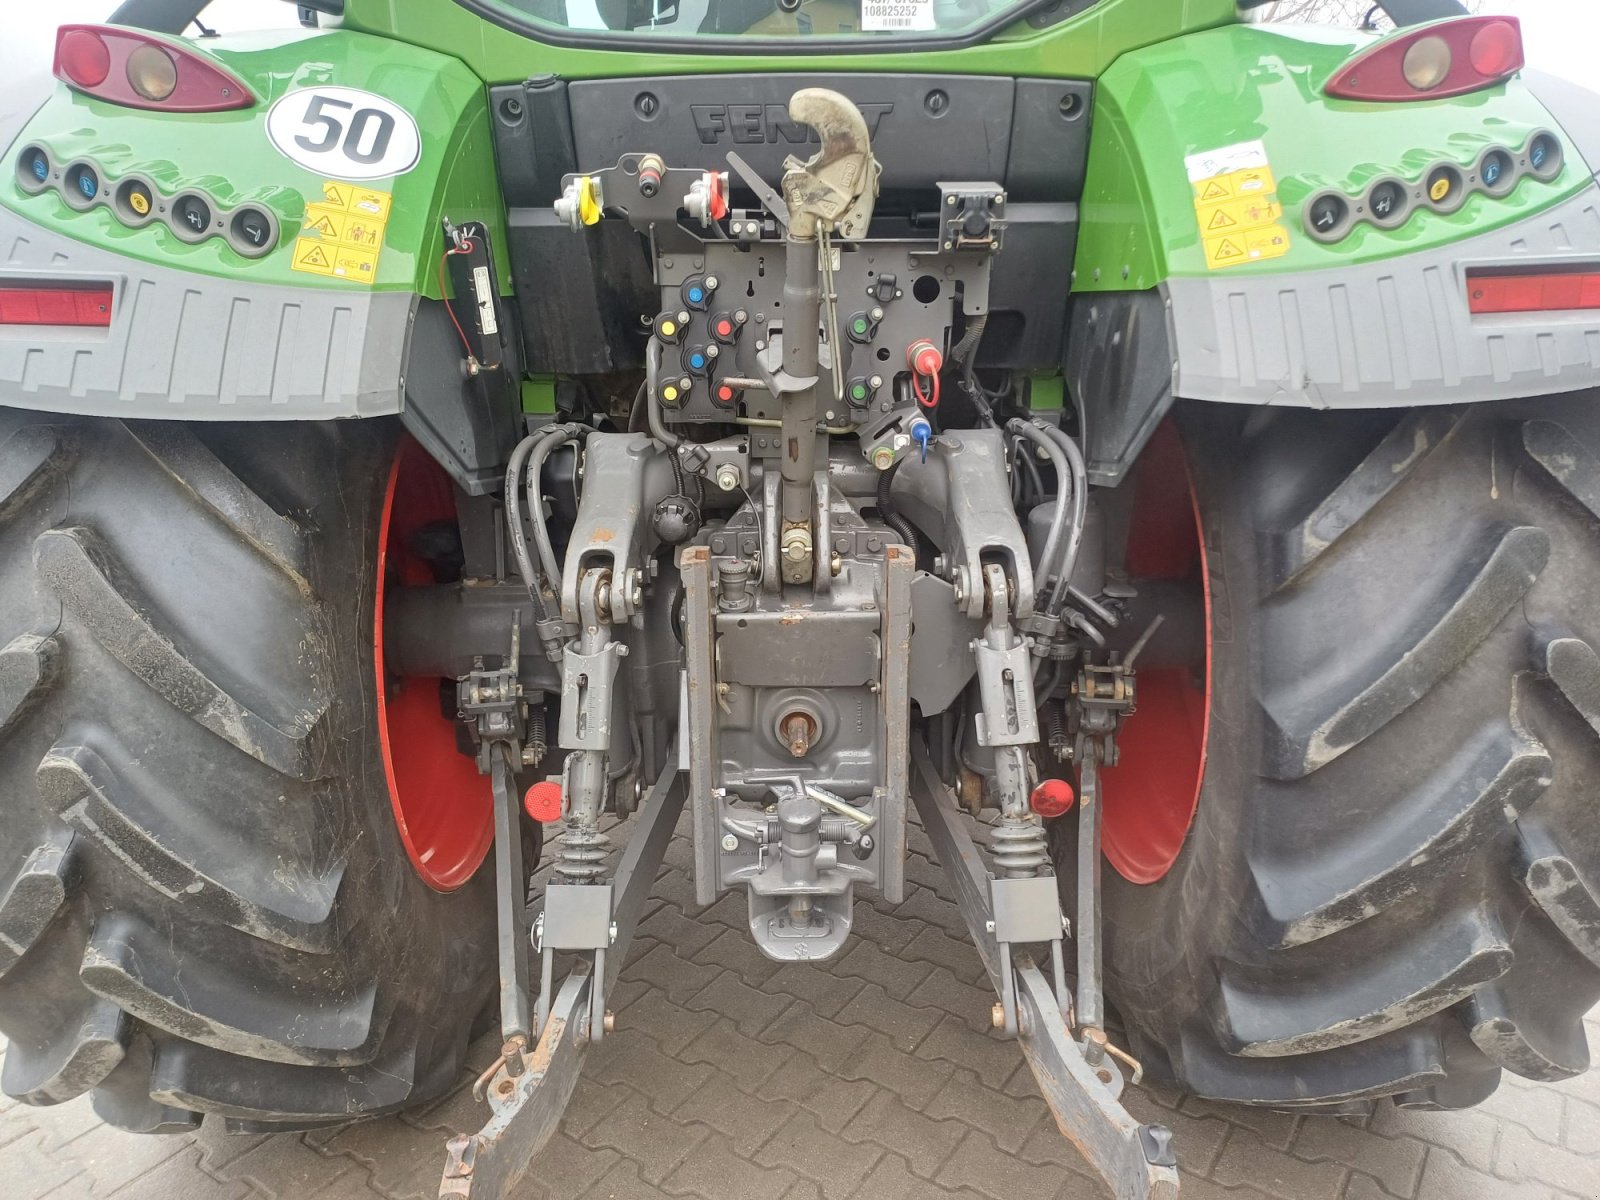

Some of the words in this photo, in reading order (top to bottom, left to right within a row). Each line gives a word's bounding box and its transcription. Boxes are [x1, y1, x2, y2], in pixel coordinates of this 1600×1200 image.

[864, 5, 917, 17] 108825252
[294, 94, 396, 165] 50
[690, 103, 894, 144] FENT
